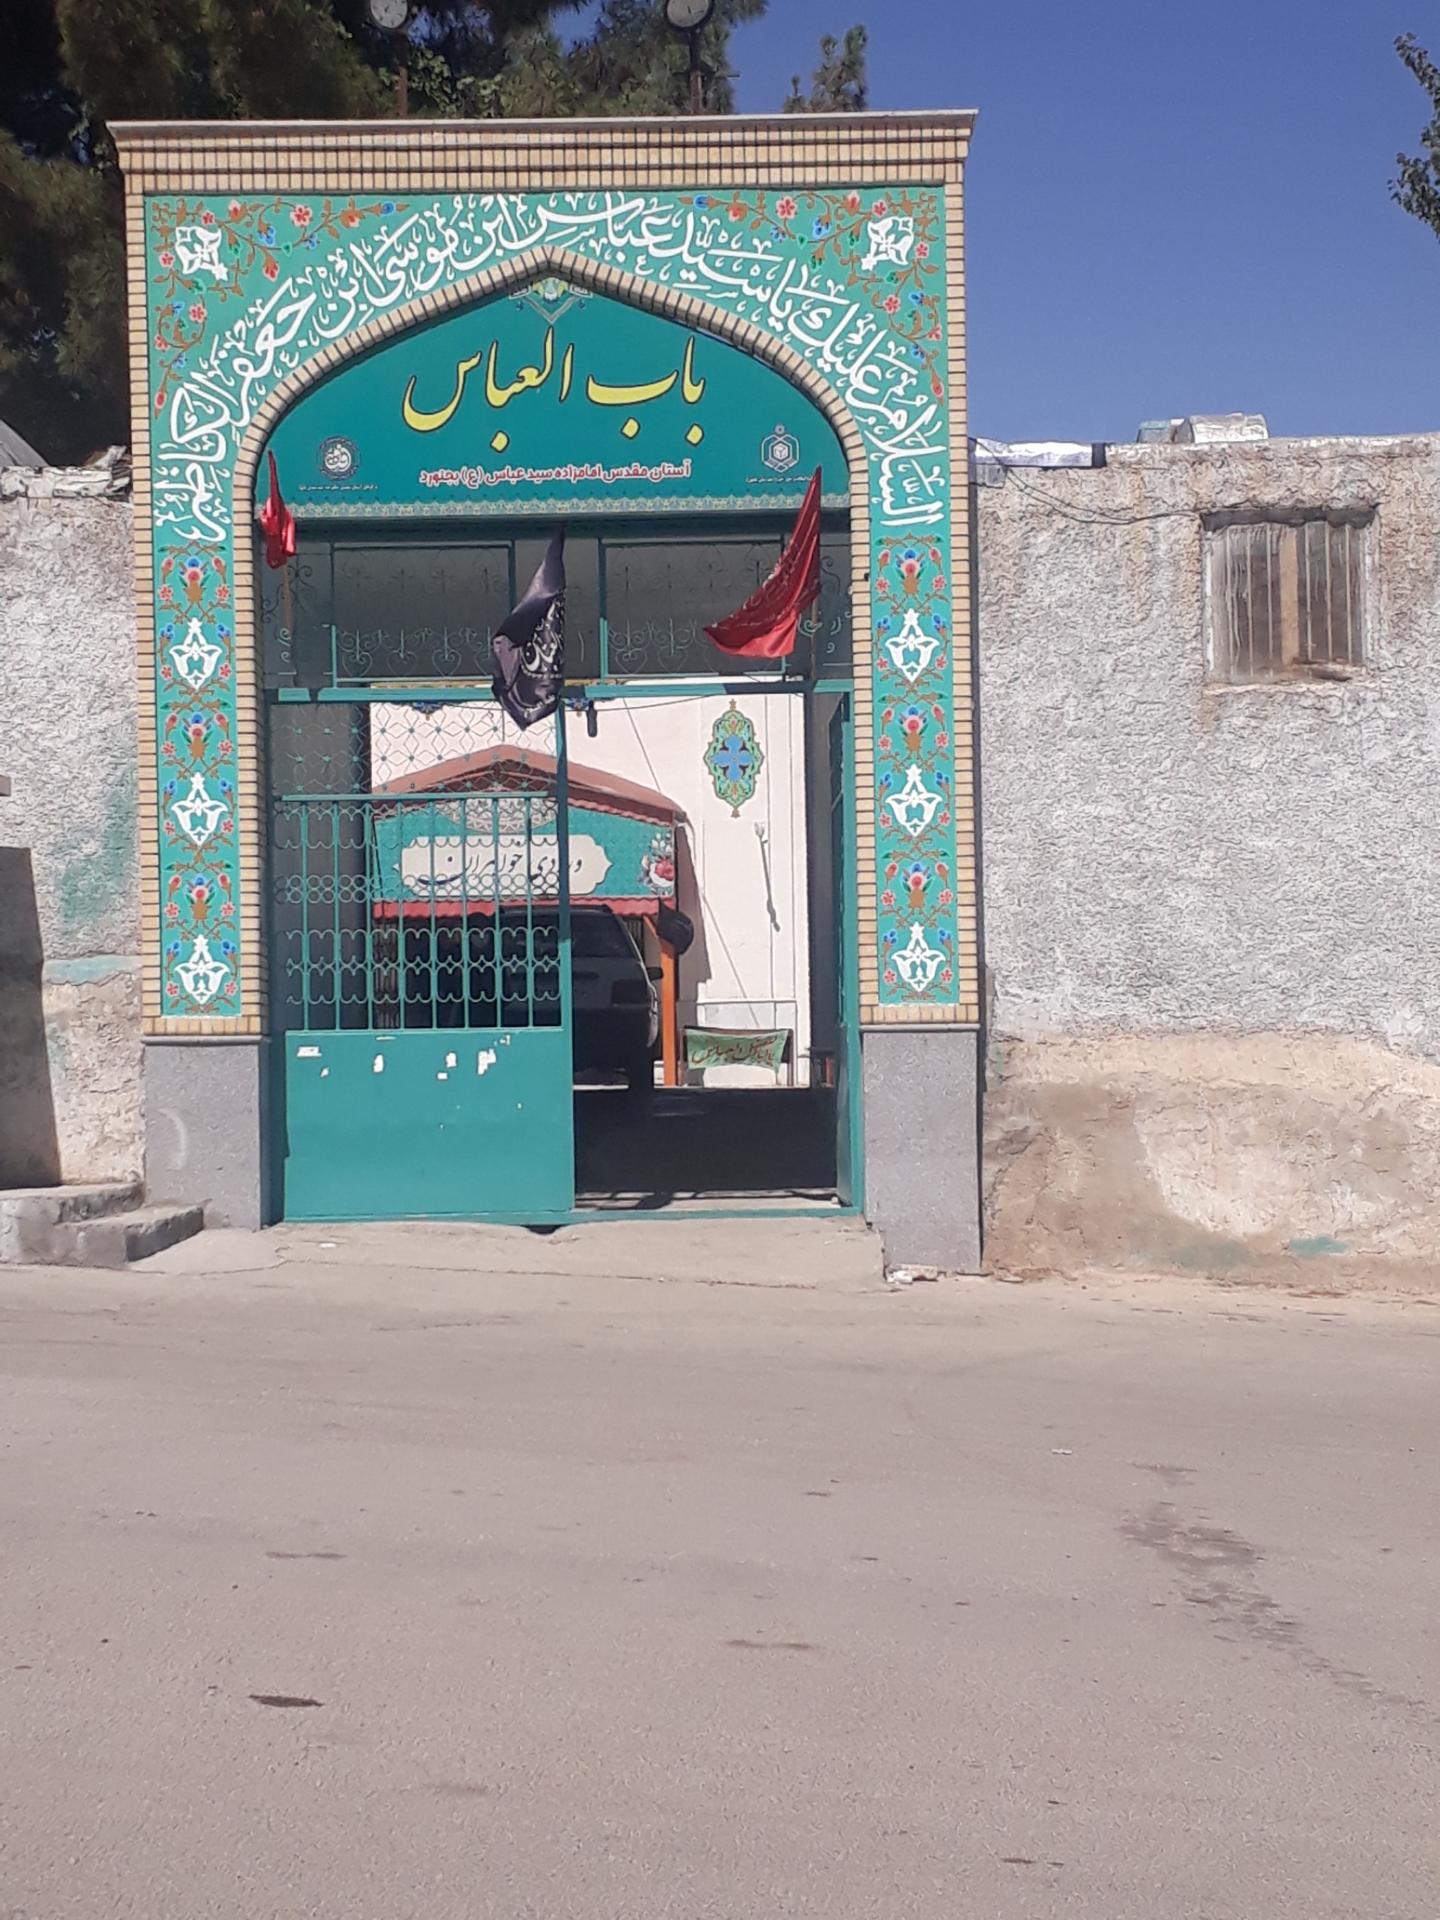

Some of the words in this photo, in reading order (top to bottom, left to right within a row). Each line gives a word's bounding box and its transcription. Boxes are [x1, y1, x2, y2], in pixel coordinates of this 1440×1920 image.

[402, 325, 575, 453] العباس
[585, 336, 705, 446] باب
[419, 469, 460, 487] بجنورد
[483, 465, 525, 486] عباس
[526, 467, 554, 484] سید
[553, 463, 603, 483] امامزاده
[602, 461, 649, 483] مقدس
[647, 458, 692, 482] آستان
[528, 855, 583, 882] ودی
